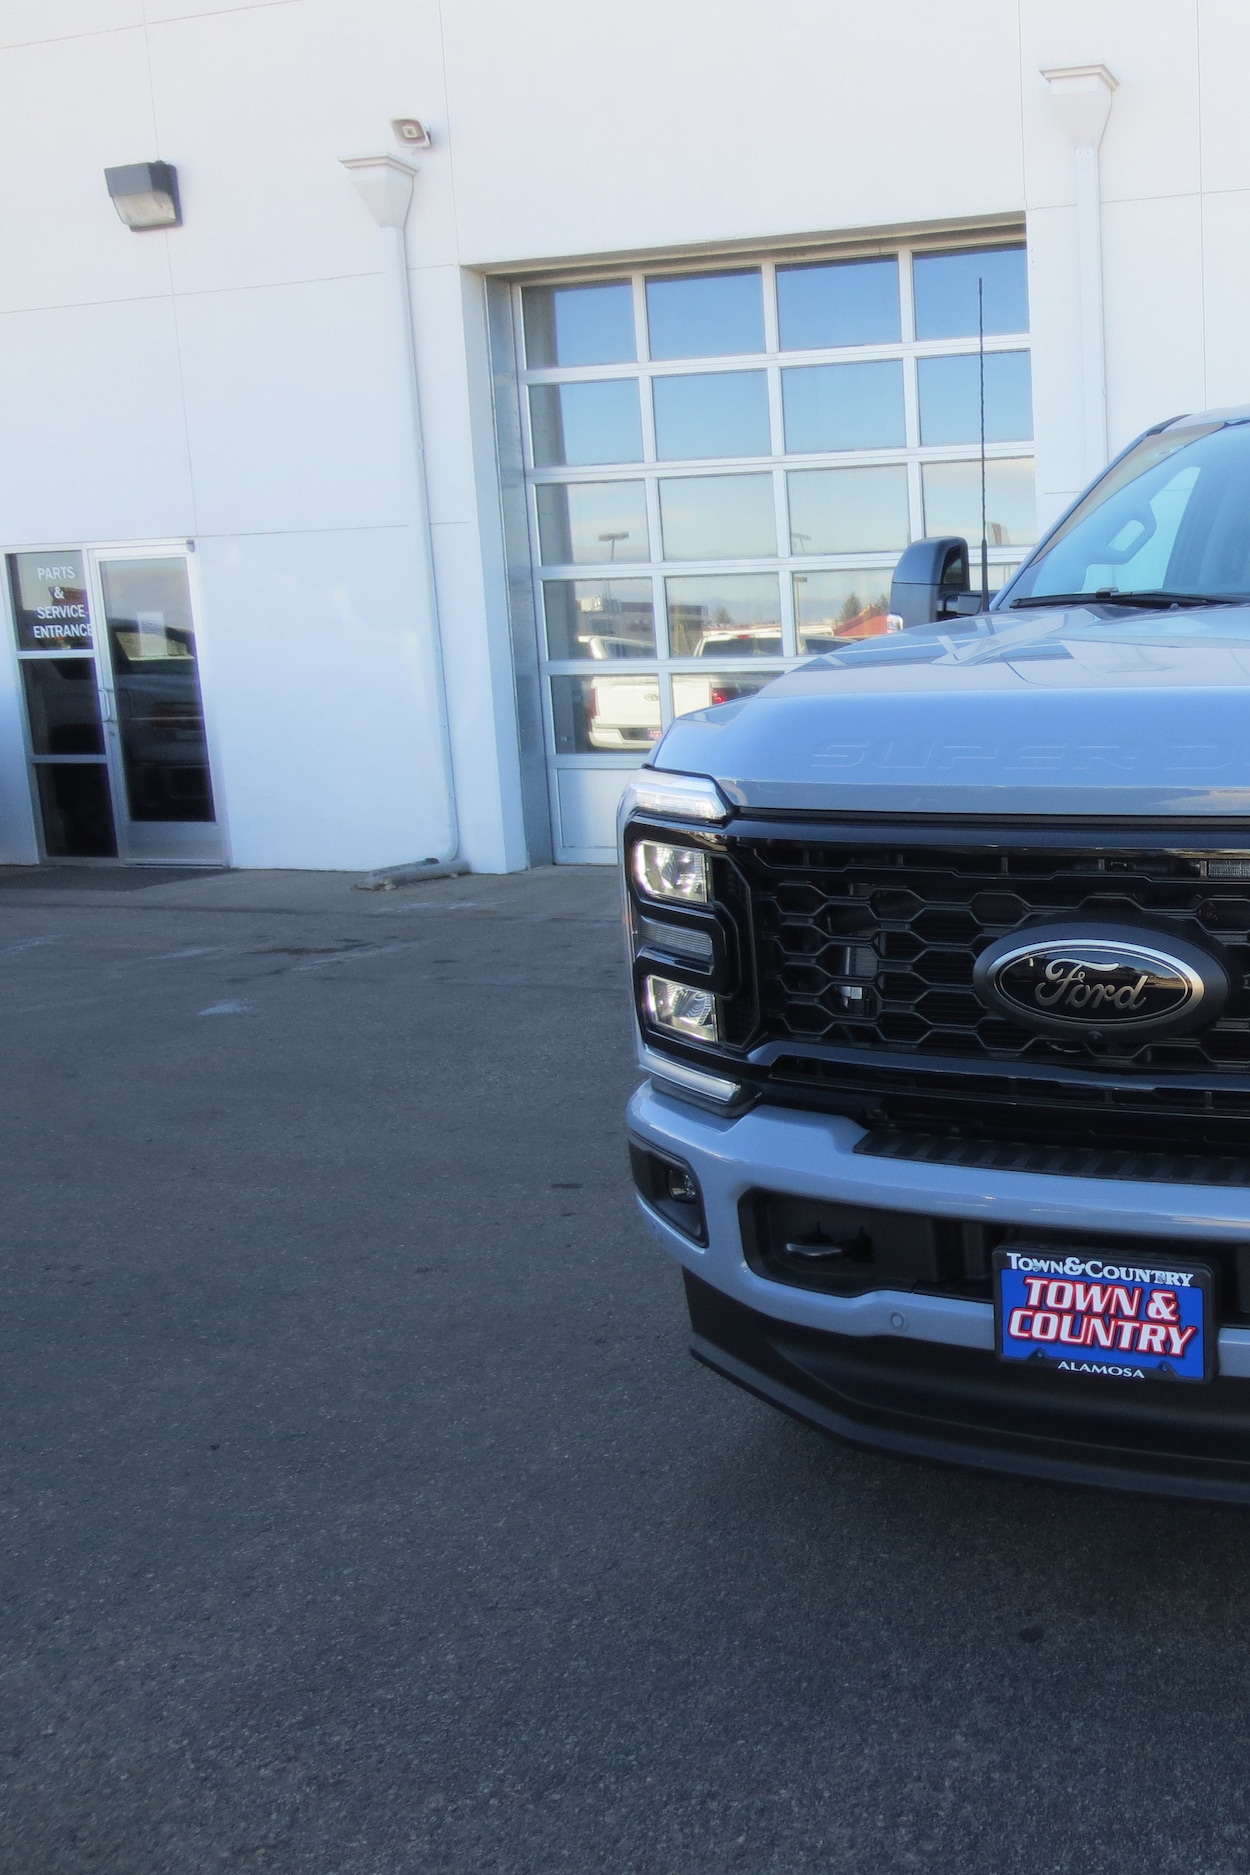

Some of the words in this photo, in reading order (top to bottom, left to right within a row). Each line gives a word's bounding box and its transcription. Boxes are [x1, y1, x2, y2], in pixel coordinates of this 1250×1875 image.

[37, 565, 76, 581] PARTS
[53, 585, 65, 600] &
[36, 603, 86, 620] SERVICE
[33, 622, 93, 639] ENTRANCE
[809, 741, 1138, 770] SUPER
[1035, 958, 1149, 1011] Ford
[1024, 1276, 1143, 1318] TOWN
[1147, 1290, 1180, 1322] &
[1008, 1307, 1197, 1357] COUNTRY
[1057, 1360, 1146, 1379] ALAMOSA
